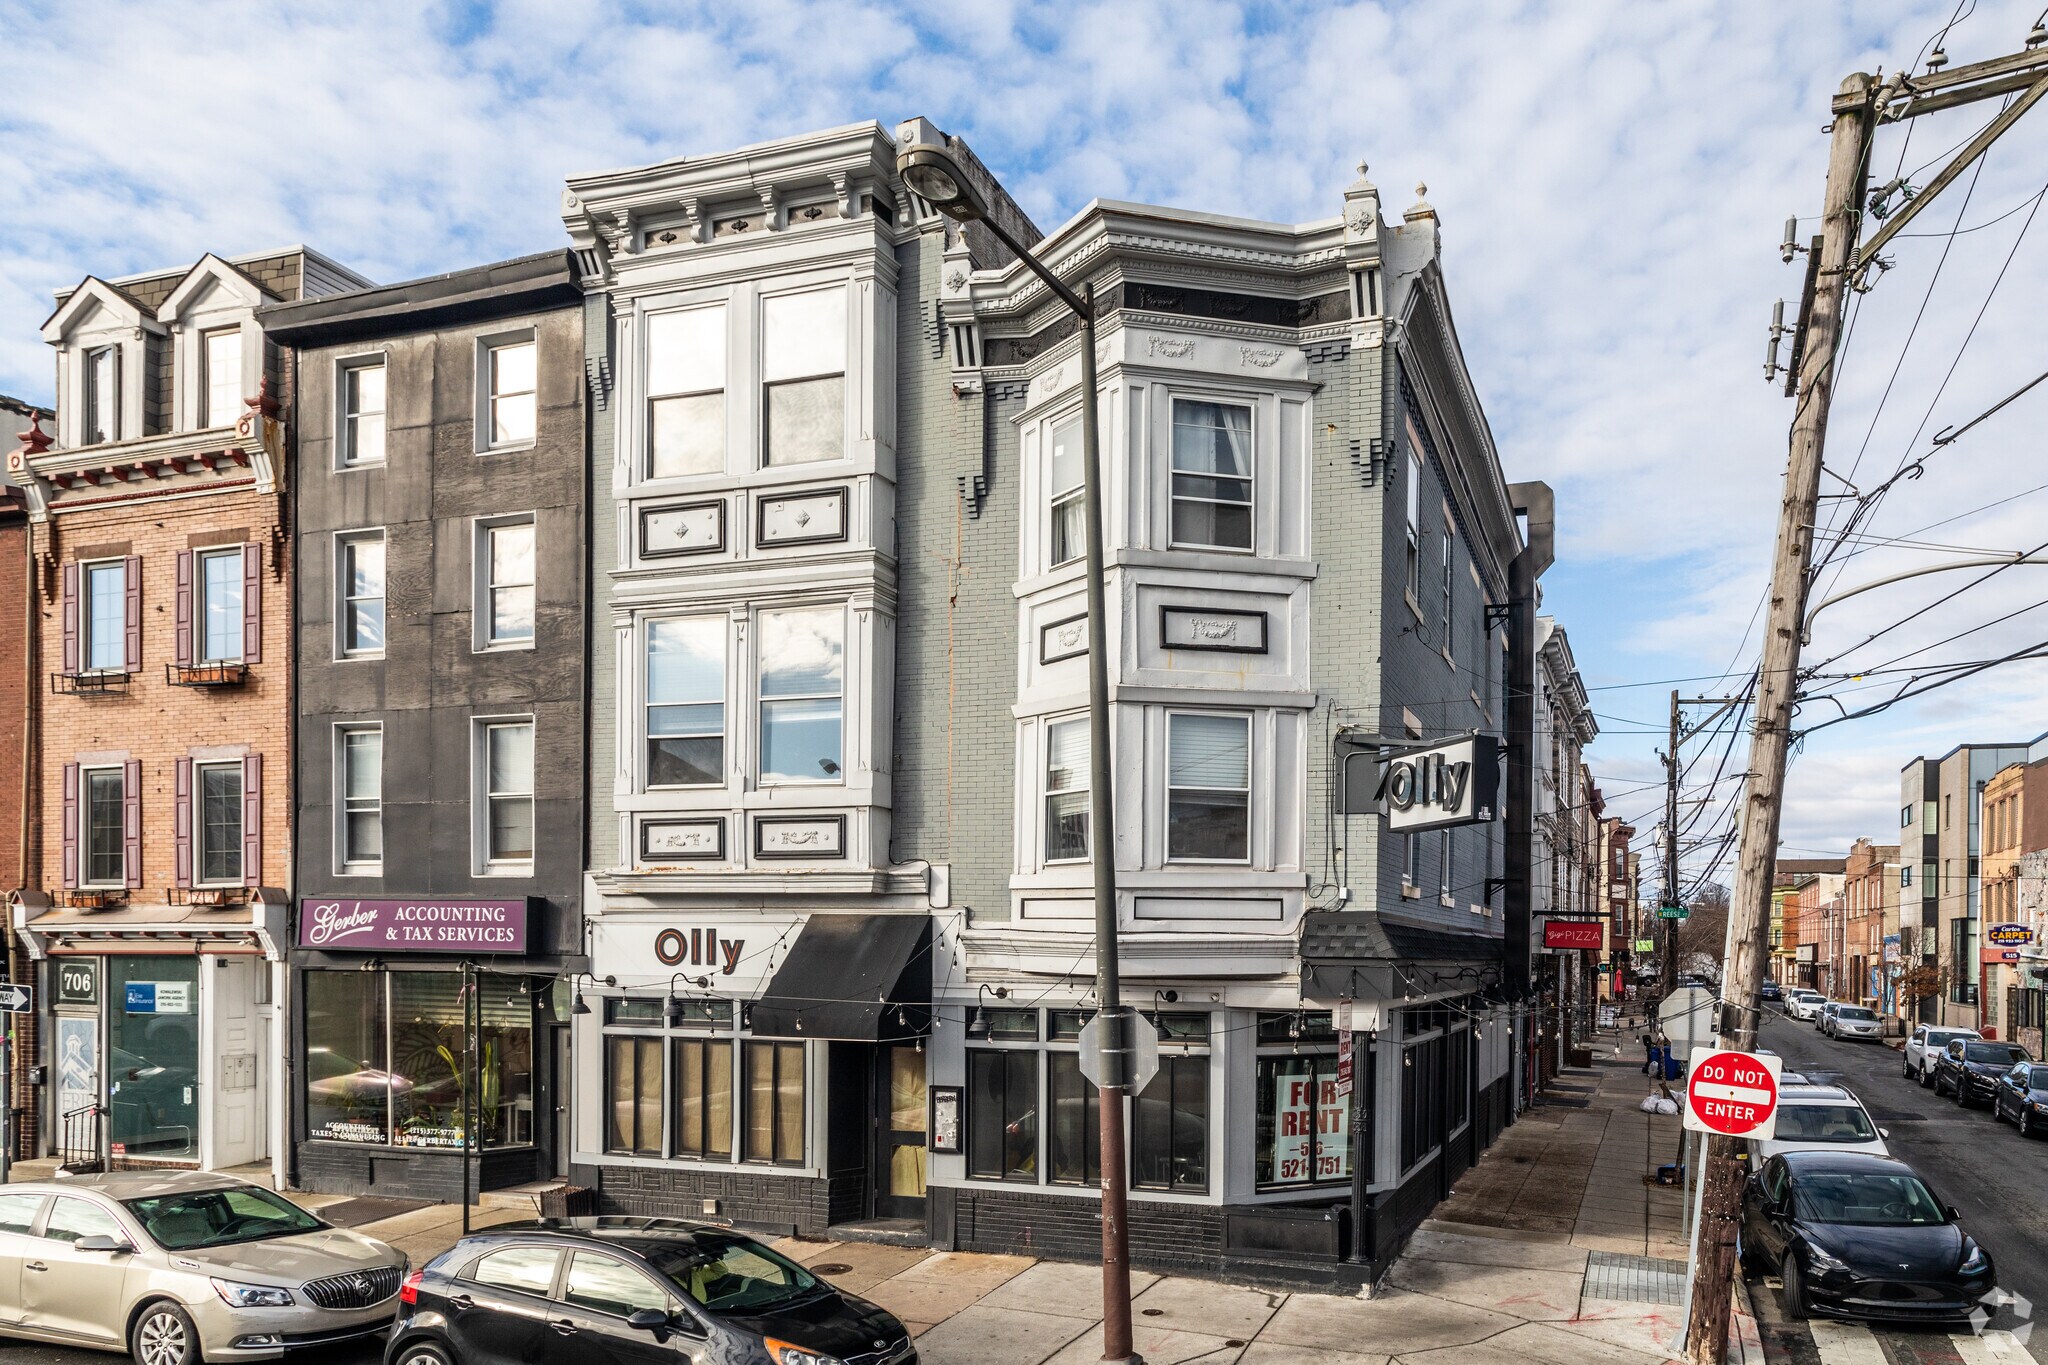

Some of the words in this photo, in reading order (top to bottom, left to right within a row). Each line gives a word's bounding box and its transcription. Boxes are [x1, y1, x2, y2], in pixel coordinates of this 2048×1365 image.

[310, 902, 378, 944] Gerber
[395, 906, 506, 922] ACCOUNTING
[385, 927, 398, 941] &
[403, 926, 434, 941] TAX
[437, 927, 515, 943] SERVICES
[1565, 930, 1601, 941] PIZZA
[1991, 931, 2032, 939] CARPET
[654, 928, 745, 976] Olly
[64, 973, 91, 992] 706
[1703, 1065, 1725, 1080] DO
[1734, 1069, 1766, 1085] NOT
[1290, 1080, 1337, 1107] FOR
[1705, 1101, 1755, 1121] ENTER
[311, 1129, 333, 1137] TAXES
[1281, 1109, 1344, 1137] RENT
